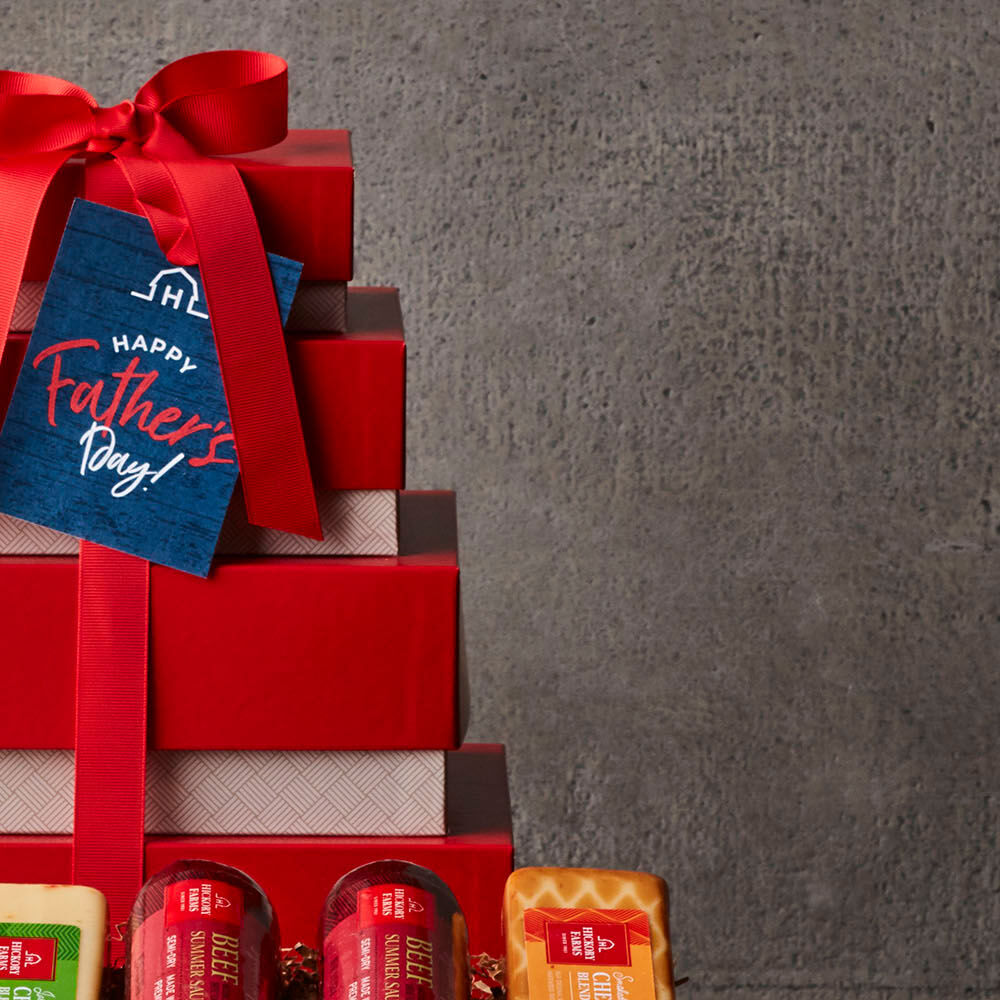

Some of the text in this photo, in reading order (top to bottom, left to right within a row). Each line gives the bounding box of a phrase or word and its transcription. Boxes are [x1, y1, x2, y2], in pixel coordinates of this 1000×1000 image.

[161, 285, 183, 309] H
[112, 334, 197, 373] HAPPY
[32, 338, 238, 468] Father's
[80, 421, 184, 497] Day!
[188, 888, 200, 912] FARMS
[200, 884, 212, 915] HICKORY
[382, 893, 392, 916] FARMS
[393, 888, 405, 919] HICKORY
[9, 941, 22, 975] HICKORY
[166, 935, 176, 968] SEMI-DRY
[189, 931, 206, 979] SUMMER
[211, 932, 239, 986] BEEF
[360, 938, 371, 971] SEMI-DRY
[384, 934, 401, 980] SUMMER
[570, 931, 582, 956] FARMS
[582, 927, 595, 961] HICKORY
[406, 936, 433, 988] BEEF
[165, 974, 176, 995] MADE
[360, 976, 370, 997] MADE
[576, 972, 591, 1000] BLEND
